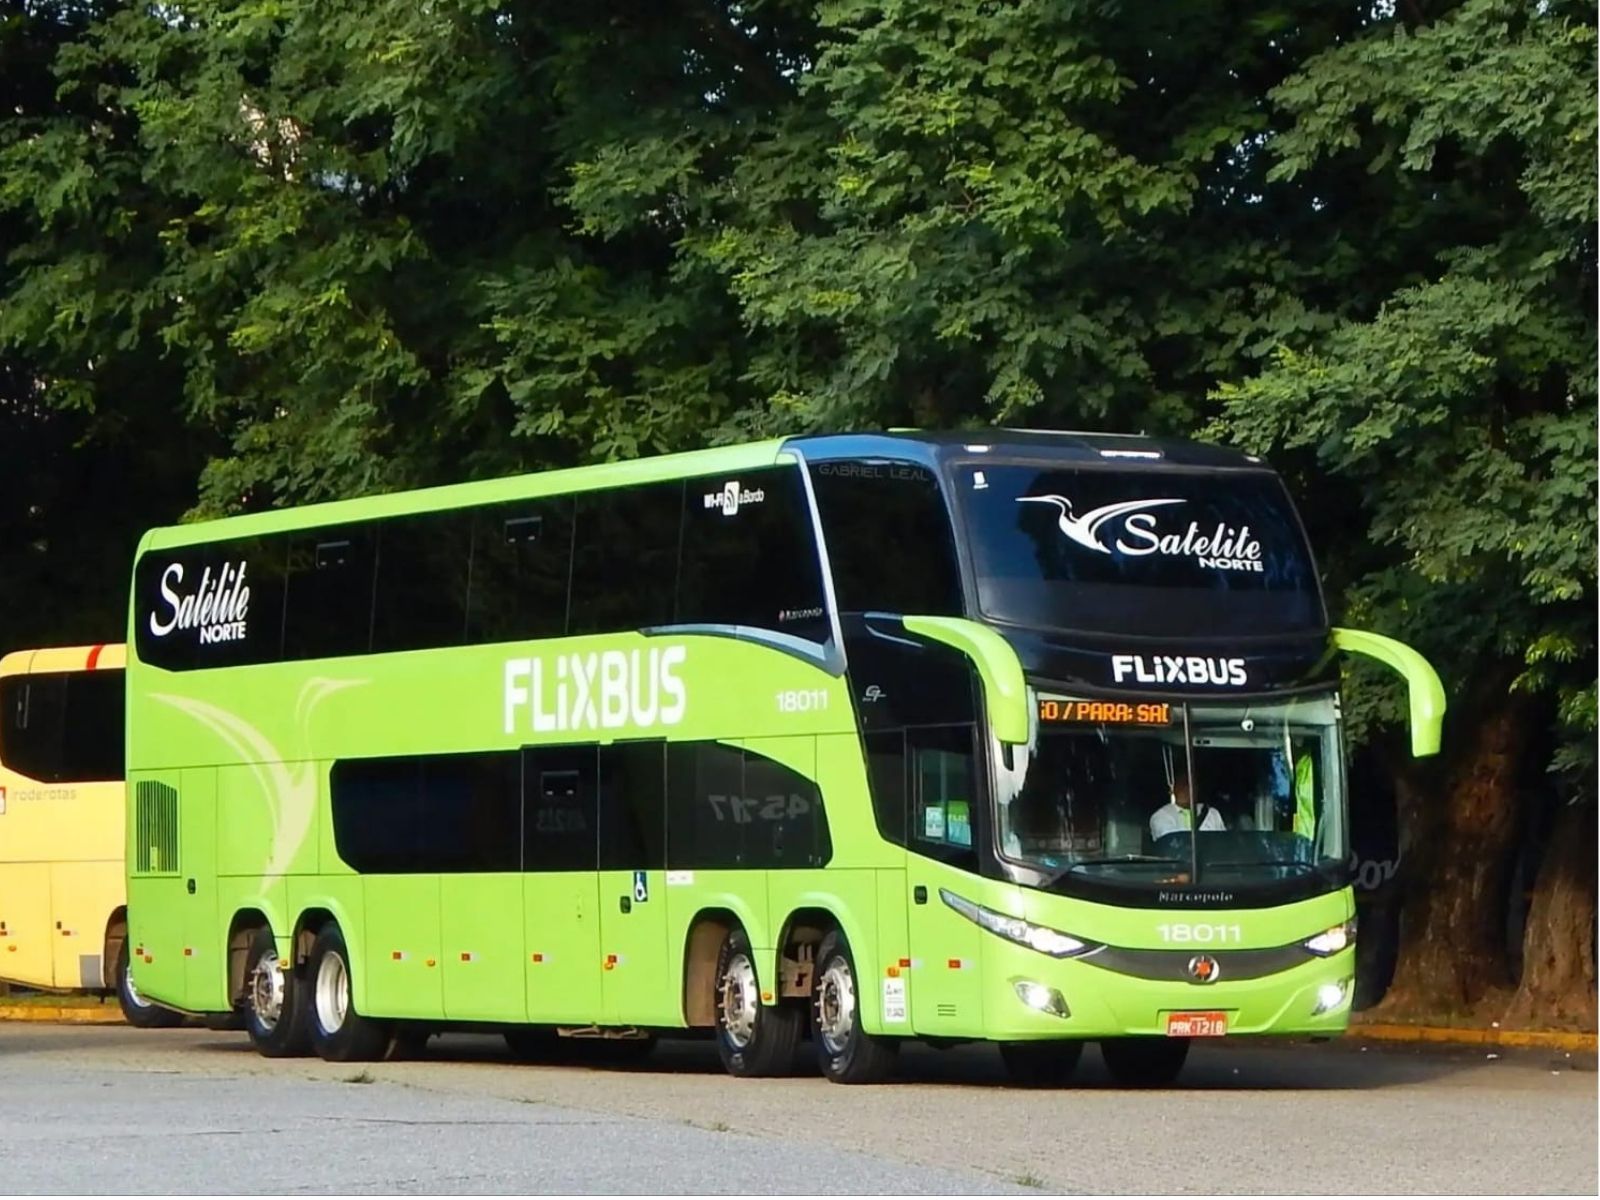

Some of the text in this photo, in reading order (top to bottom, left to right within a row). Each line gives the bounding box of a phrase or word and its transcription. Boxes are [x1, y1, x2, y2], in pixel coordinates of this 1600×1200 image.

[1199, 557, 1264, 572] NORTE
[149, 561, 250, 636] Satélite
[200, 621, 247, 644] NORTE
[775, 688, 829, 712] 18011
[1155, 923, 1242, 943] 18011
